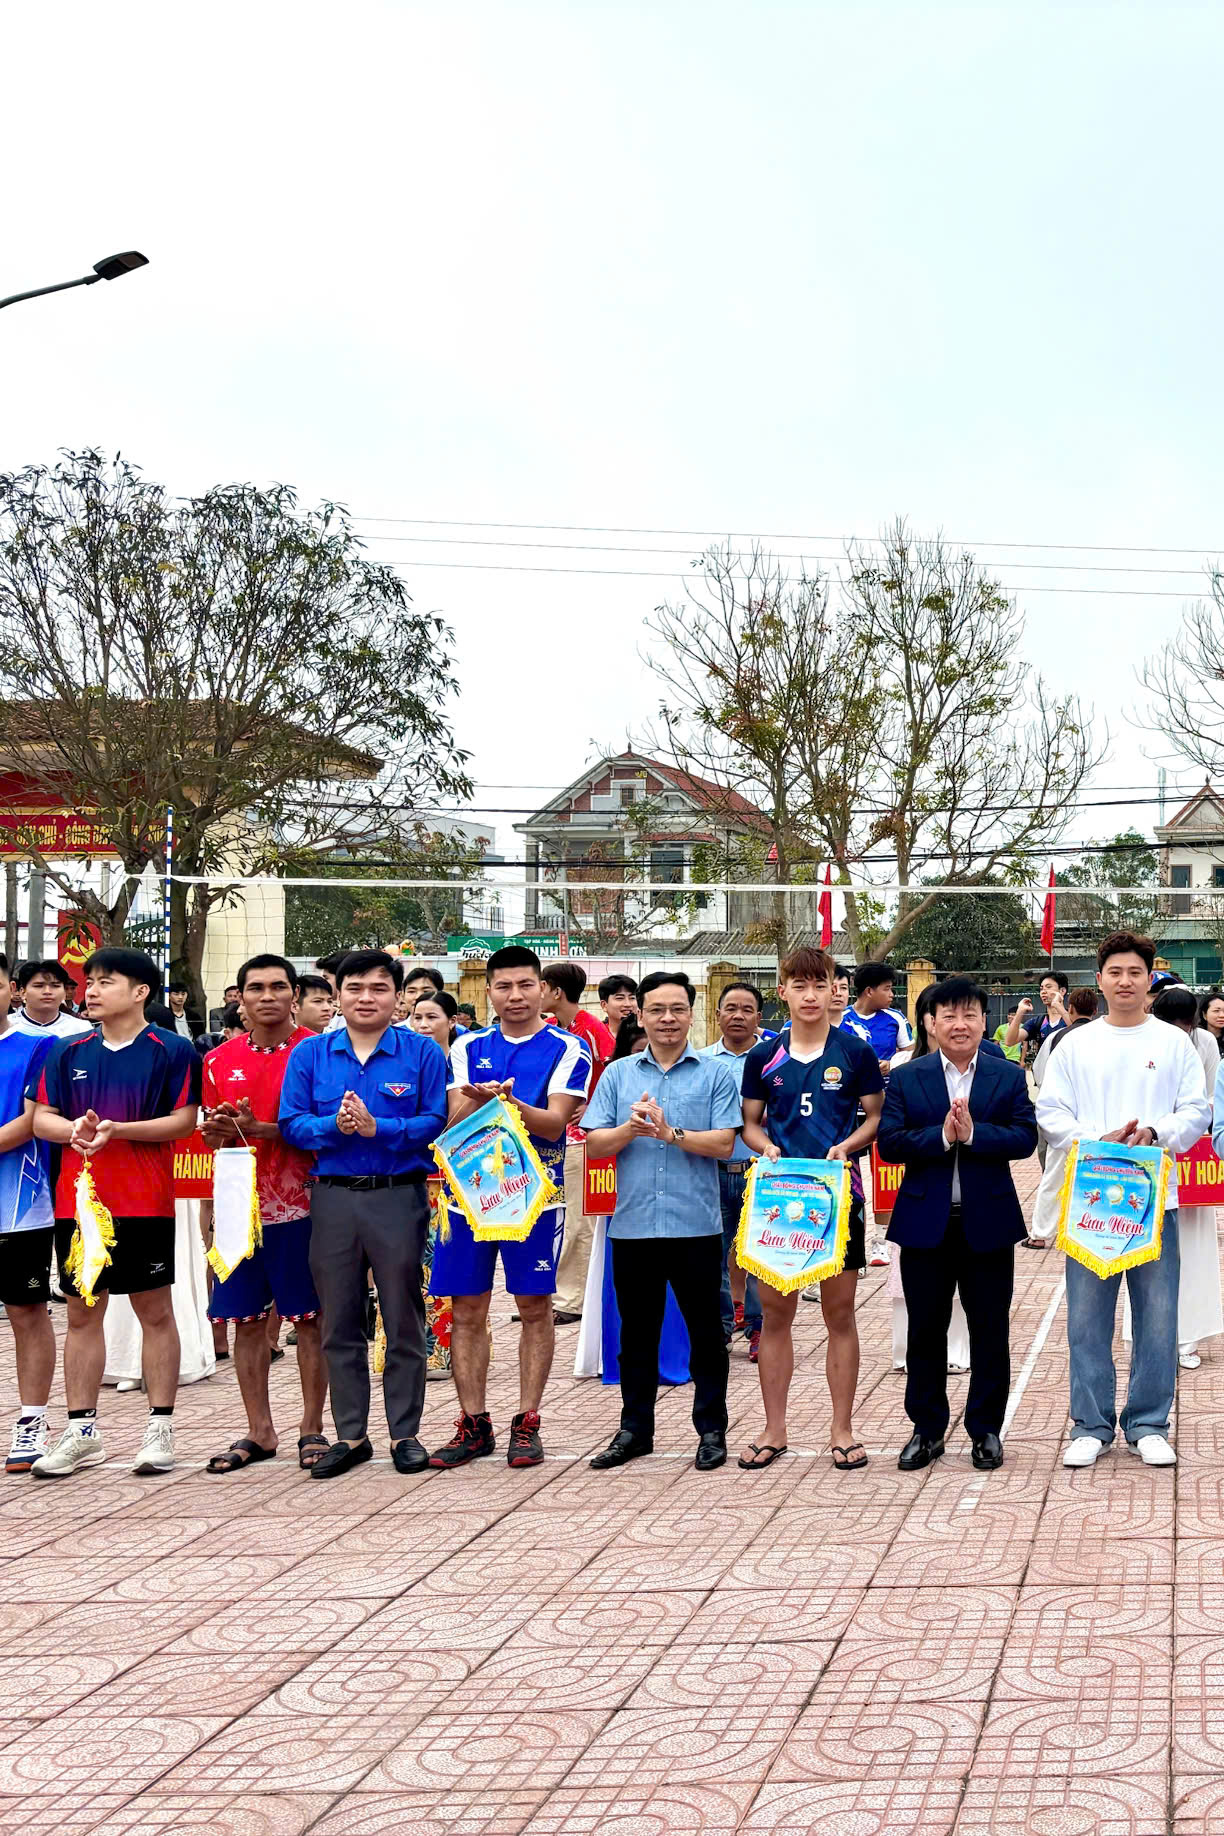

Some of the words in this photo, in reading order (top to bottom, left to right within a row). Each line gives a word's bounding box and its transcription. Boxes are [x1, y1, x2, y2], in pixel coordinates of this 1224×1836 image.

[800, 1092, 813, 1117] 5
[1077, 1212, 1105, 1231] Lưu
[1108, 1215, 1144, 1238] Niệm
[757, 1229, 786, 1248] Lưu
[789, 1231, 826, 1254] Niệm
